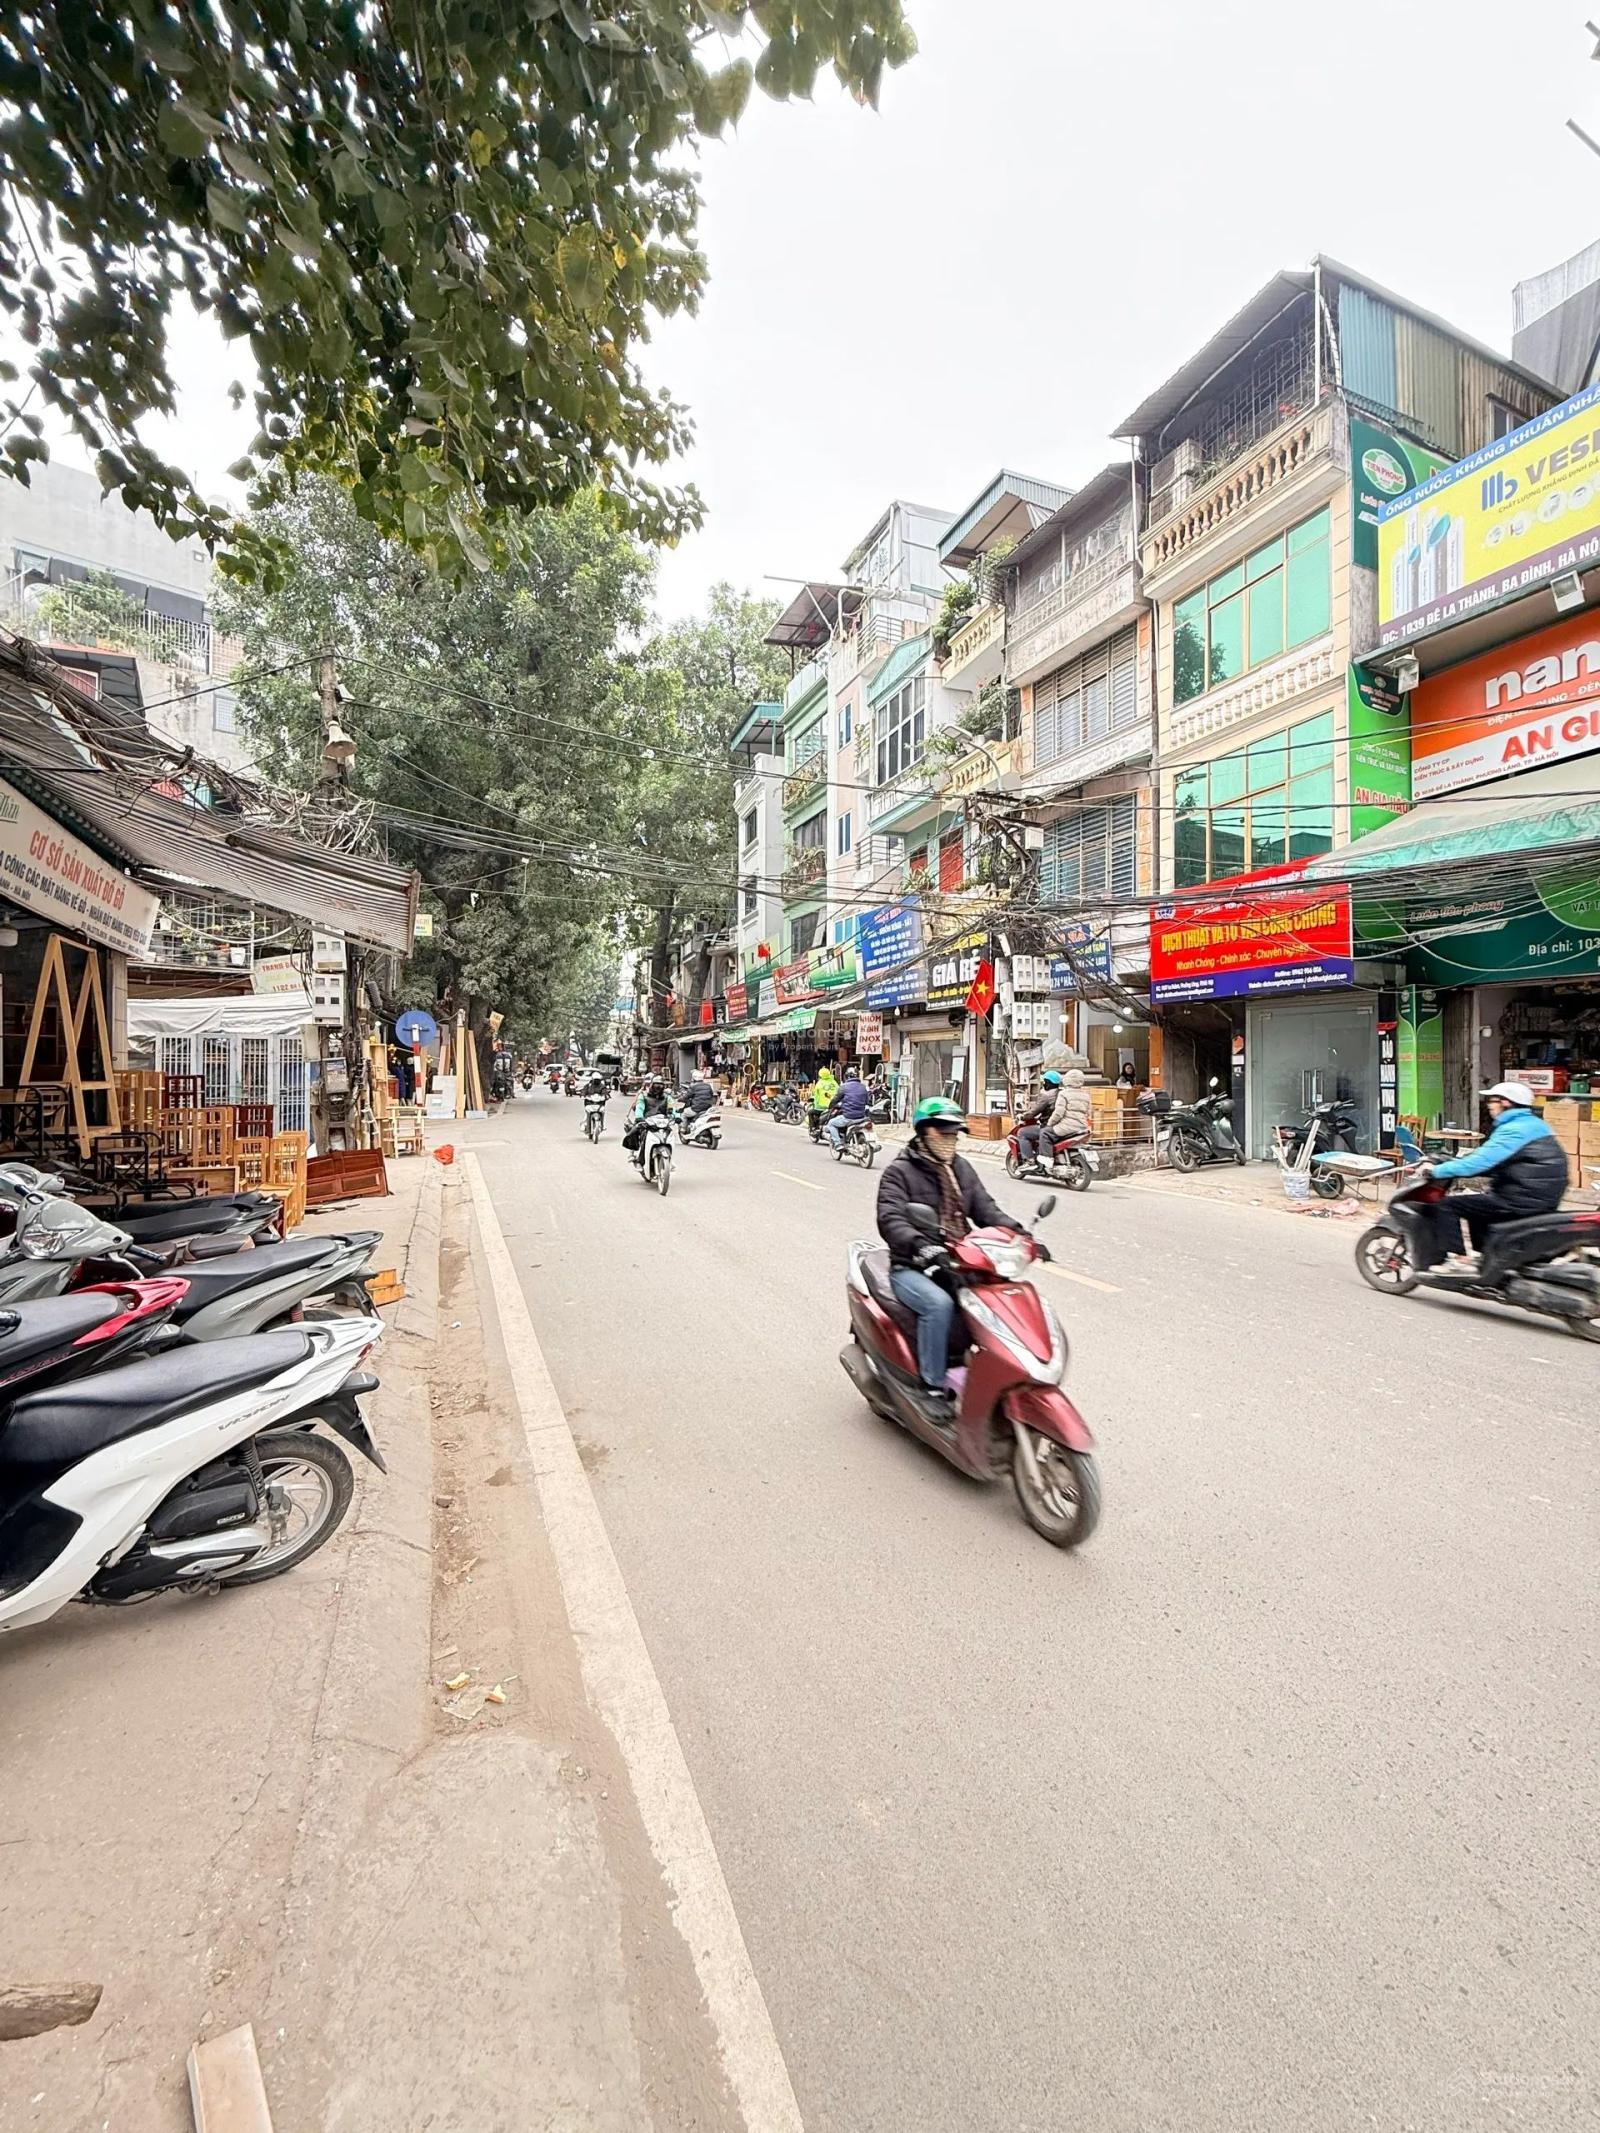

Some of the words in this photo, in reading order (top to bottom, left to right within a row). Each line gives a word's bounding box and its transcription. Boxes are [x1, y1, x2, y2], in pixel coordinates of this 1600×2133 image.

[1415, 473, 1453, 501] NƯỚC
[1455, 443, 1506, 478] KHÁNG
[1509, 410, 1565, 448] KHUẨN
[1382, 629, 1400, 646] ĐC:
[1401, 618, 1425, 637] 1039
[1442, 602, 1457, 618] LA
[1457, 583, 1499, 612] THÀNH,
[1501, 575, 1519, 593] BA
[1520, 559, 1556, 586] ĐÌNH,
[1558, 547, 1577, 568] HÀ
[1501, 725, 1555, 764] AN
[1355, 786, 1370, 804] AN
[30, 830, 50, 861] CƠ
[46, 839, 65, 872] SỞ
[61, 849, 84, 886] SẢN
[81, 866, 106, 899] XUẤT
[1529, 944, 1547, 956] Địa
[932, 956, 958, 988] GIÁ
[859, 1034, 881, 1043] INOX
